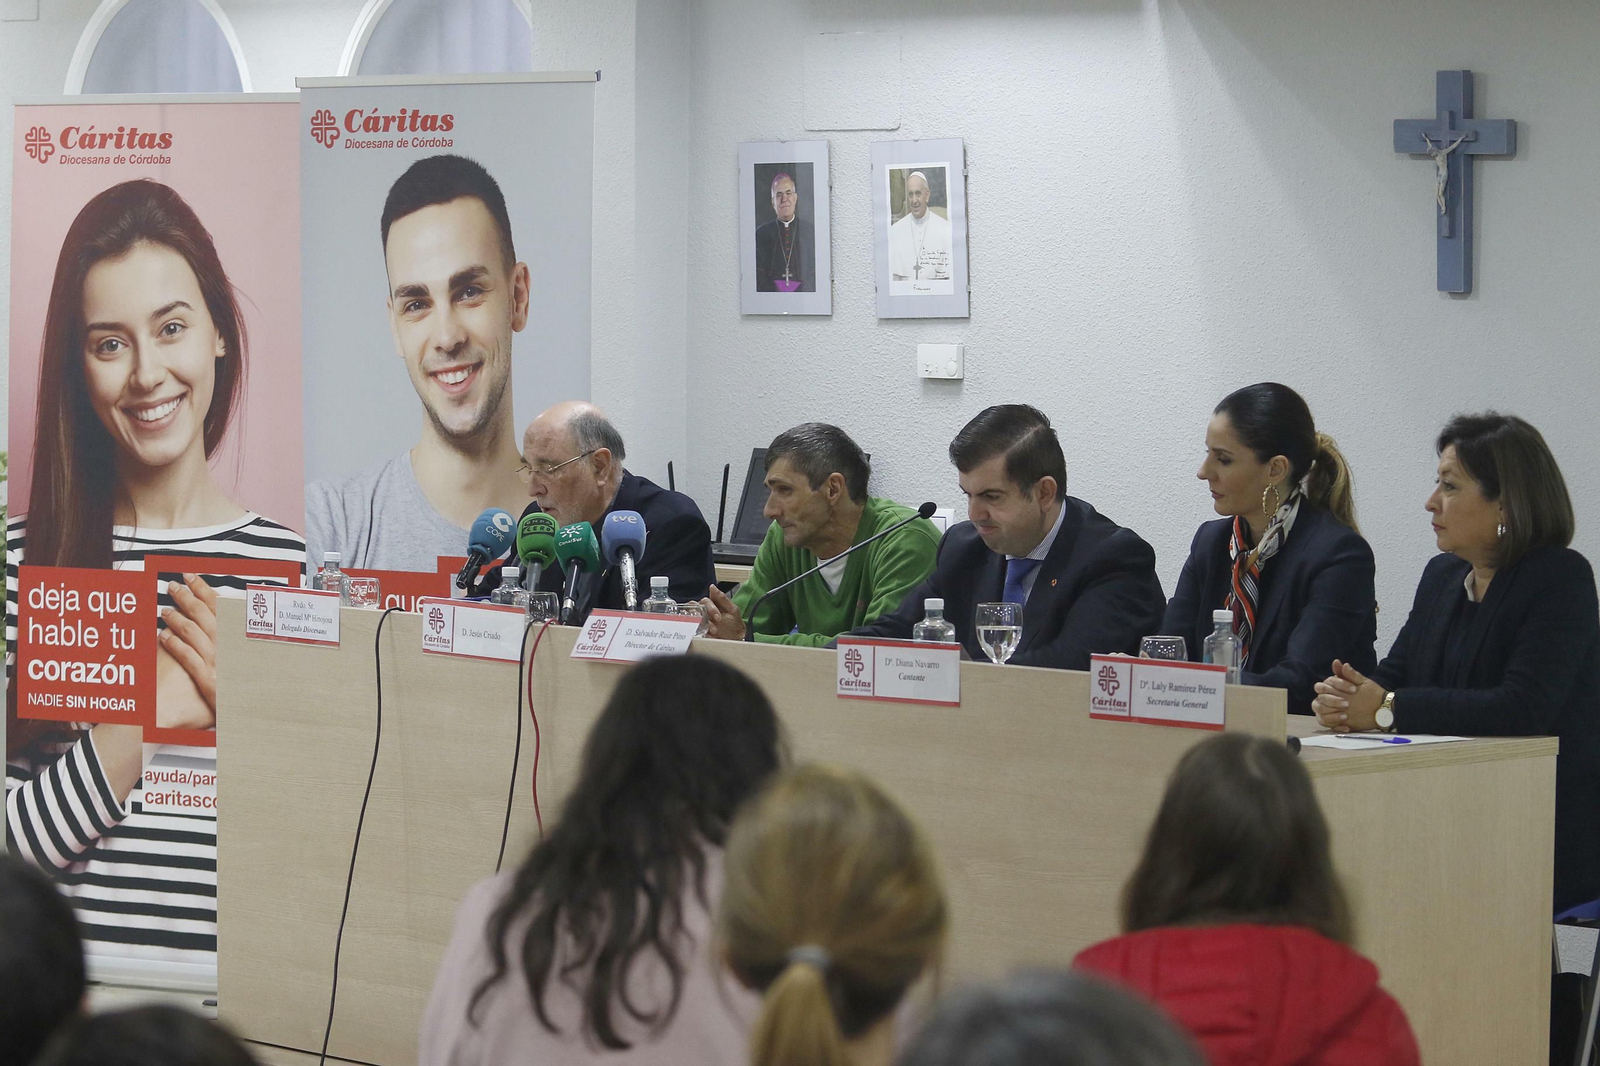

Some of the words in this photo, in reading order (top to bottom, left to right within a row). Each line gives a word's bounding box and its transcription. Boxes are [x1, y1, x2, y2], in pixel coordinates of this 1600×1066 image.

[344, 107, 455, 133] Cáritas
[59, 125, 173, 150] Cáritas
[344, 139, 394, 149] Diocesana
[396, 138, 409, 148] de
[411, 137, 454, 148] Córdoba
[59, 154, 110, 165] Diocesana
[113, 155, 126, 164] de
[129, 154, 171, 165] Córdoba
[611, 515, 638, 524] tve
[485, 525, 506, 543] COPE
[28, 582, 80, 617] deja
[88, 590, 137, 619] que
[248, 618, 273, 628] Cáritas
[28, 617, 99, 648] hable
[110, 623, 136, 650] tu
[483, 631, 501, 640] Criado
[424, 634, 450, 645] Cáritas
[576, 643, 606, 652] Cáritas
[896, 659, 914, 669] Diana
[915, 660, 940, 669] Navarro
[28, 655, 135, 686] corazón
[839, 677, 872, 688] Cáritas
[898, 672, 926, 682] Cantante
[1152, 681, 1168, 692] Laly
[28, 693, 63, 707] NADIE
[66, 695, 87, 709] SIN
[90, 697, 136, 712] HOGAR
[1092, 696, 1127, 708] Cáritas
[1146, 696, 1180, 708] Secretaria
[1181, 699, 1209, 710] General
